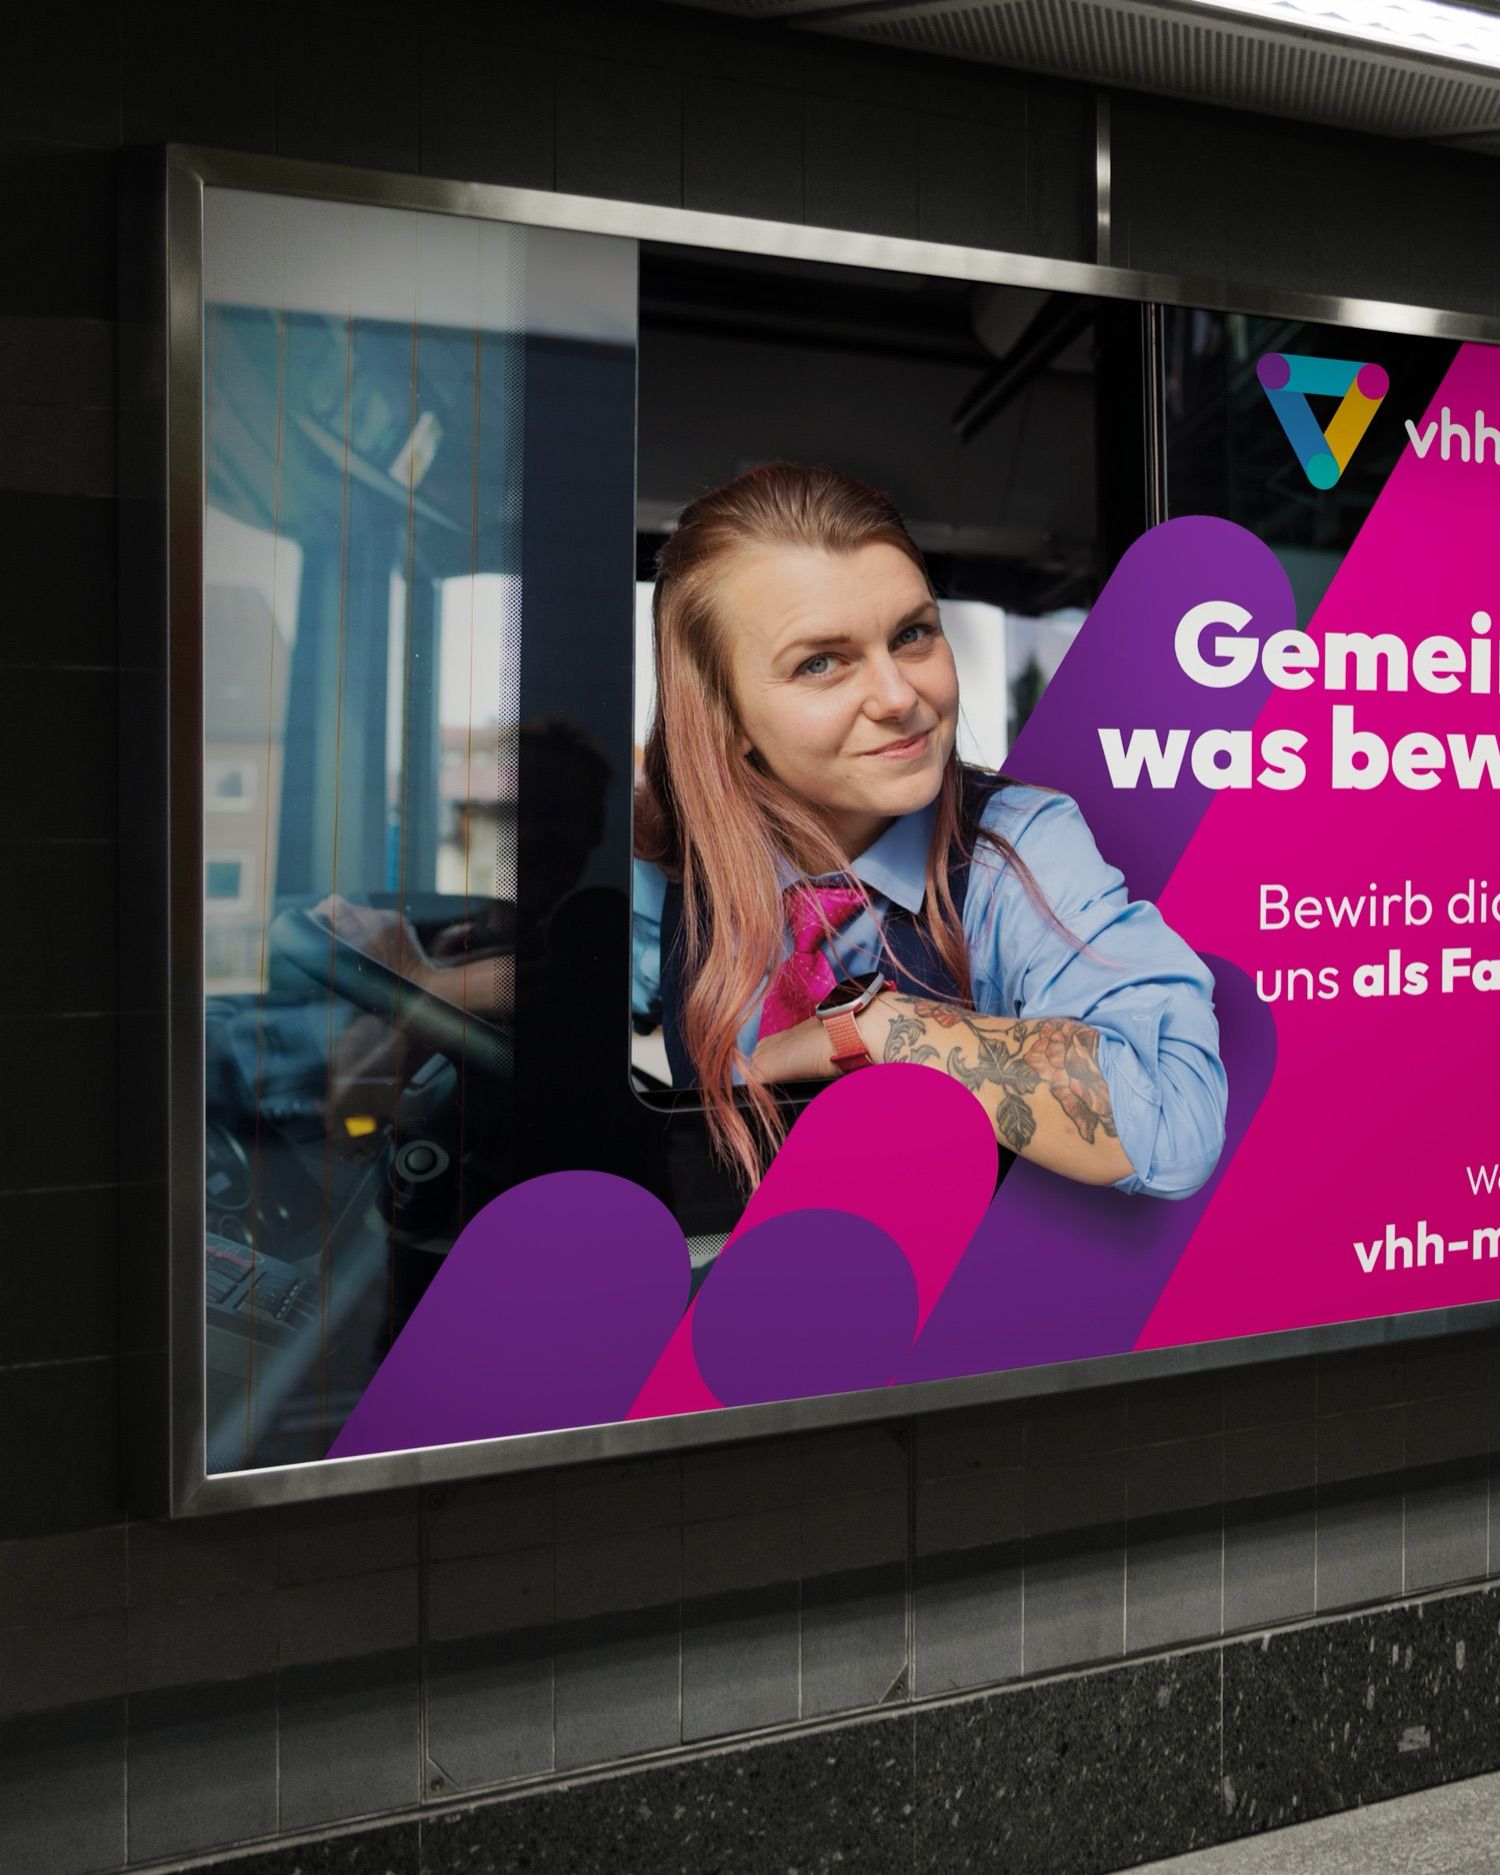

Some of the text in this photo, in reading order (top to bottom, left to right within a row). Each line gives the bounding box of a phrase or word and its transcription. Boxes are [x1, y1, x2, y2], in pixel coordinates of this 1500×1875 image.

[1098, 728, 1308, 790] was
[1259, 880, 1433, 930] Bewirb
[1257, 967, 1339, 1002] uns
[1353, 949, 1429, 997] als
